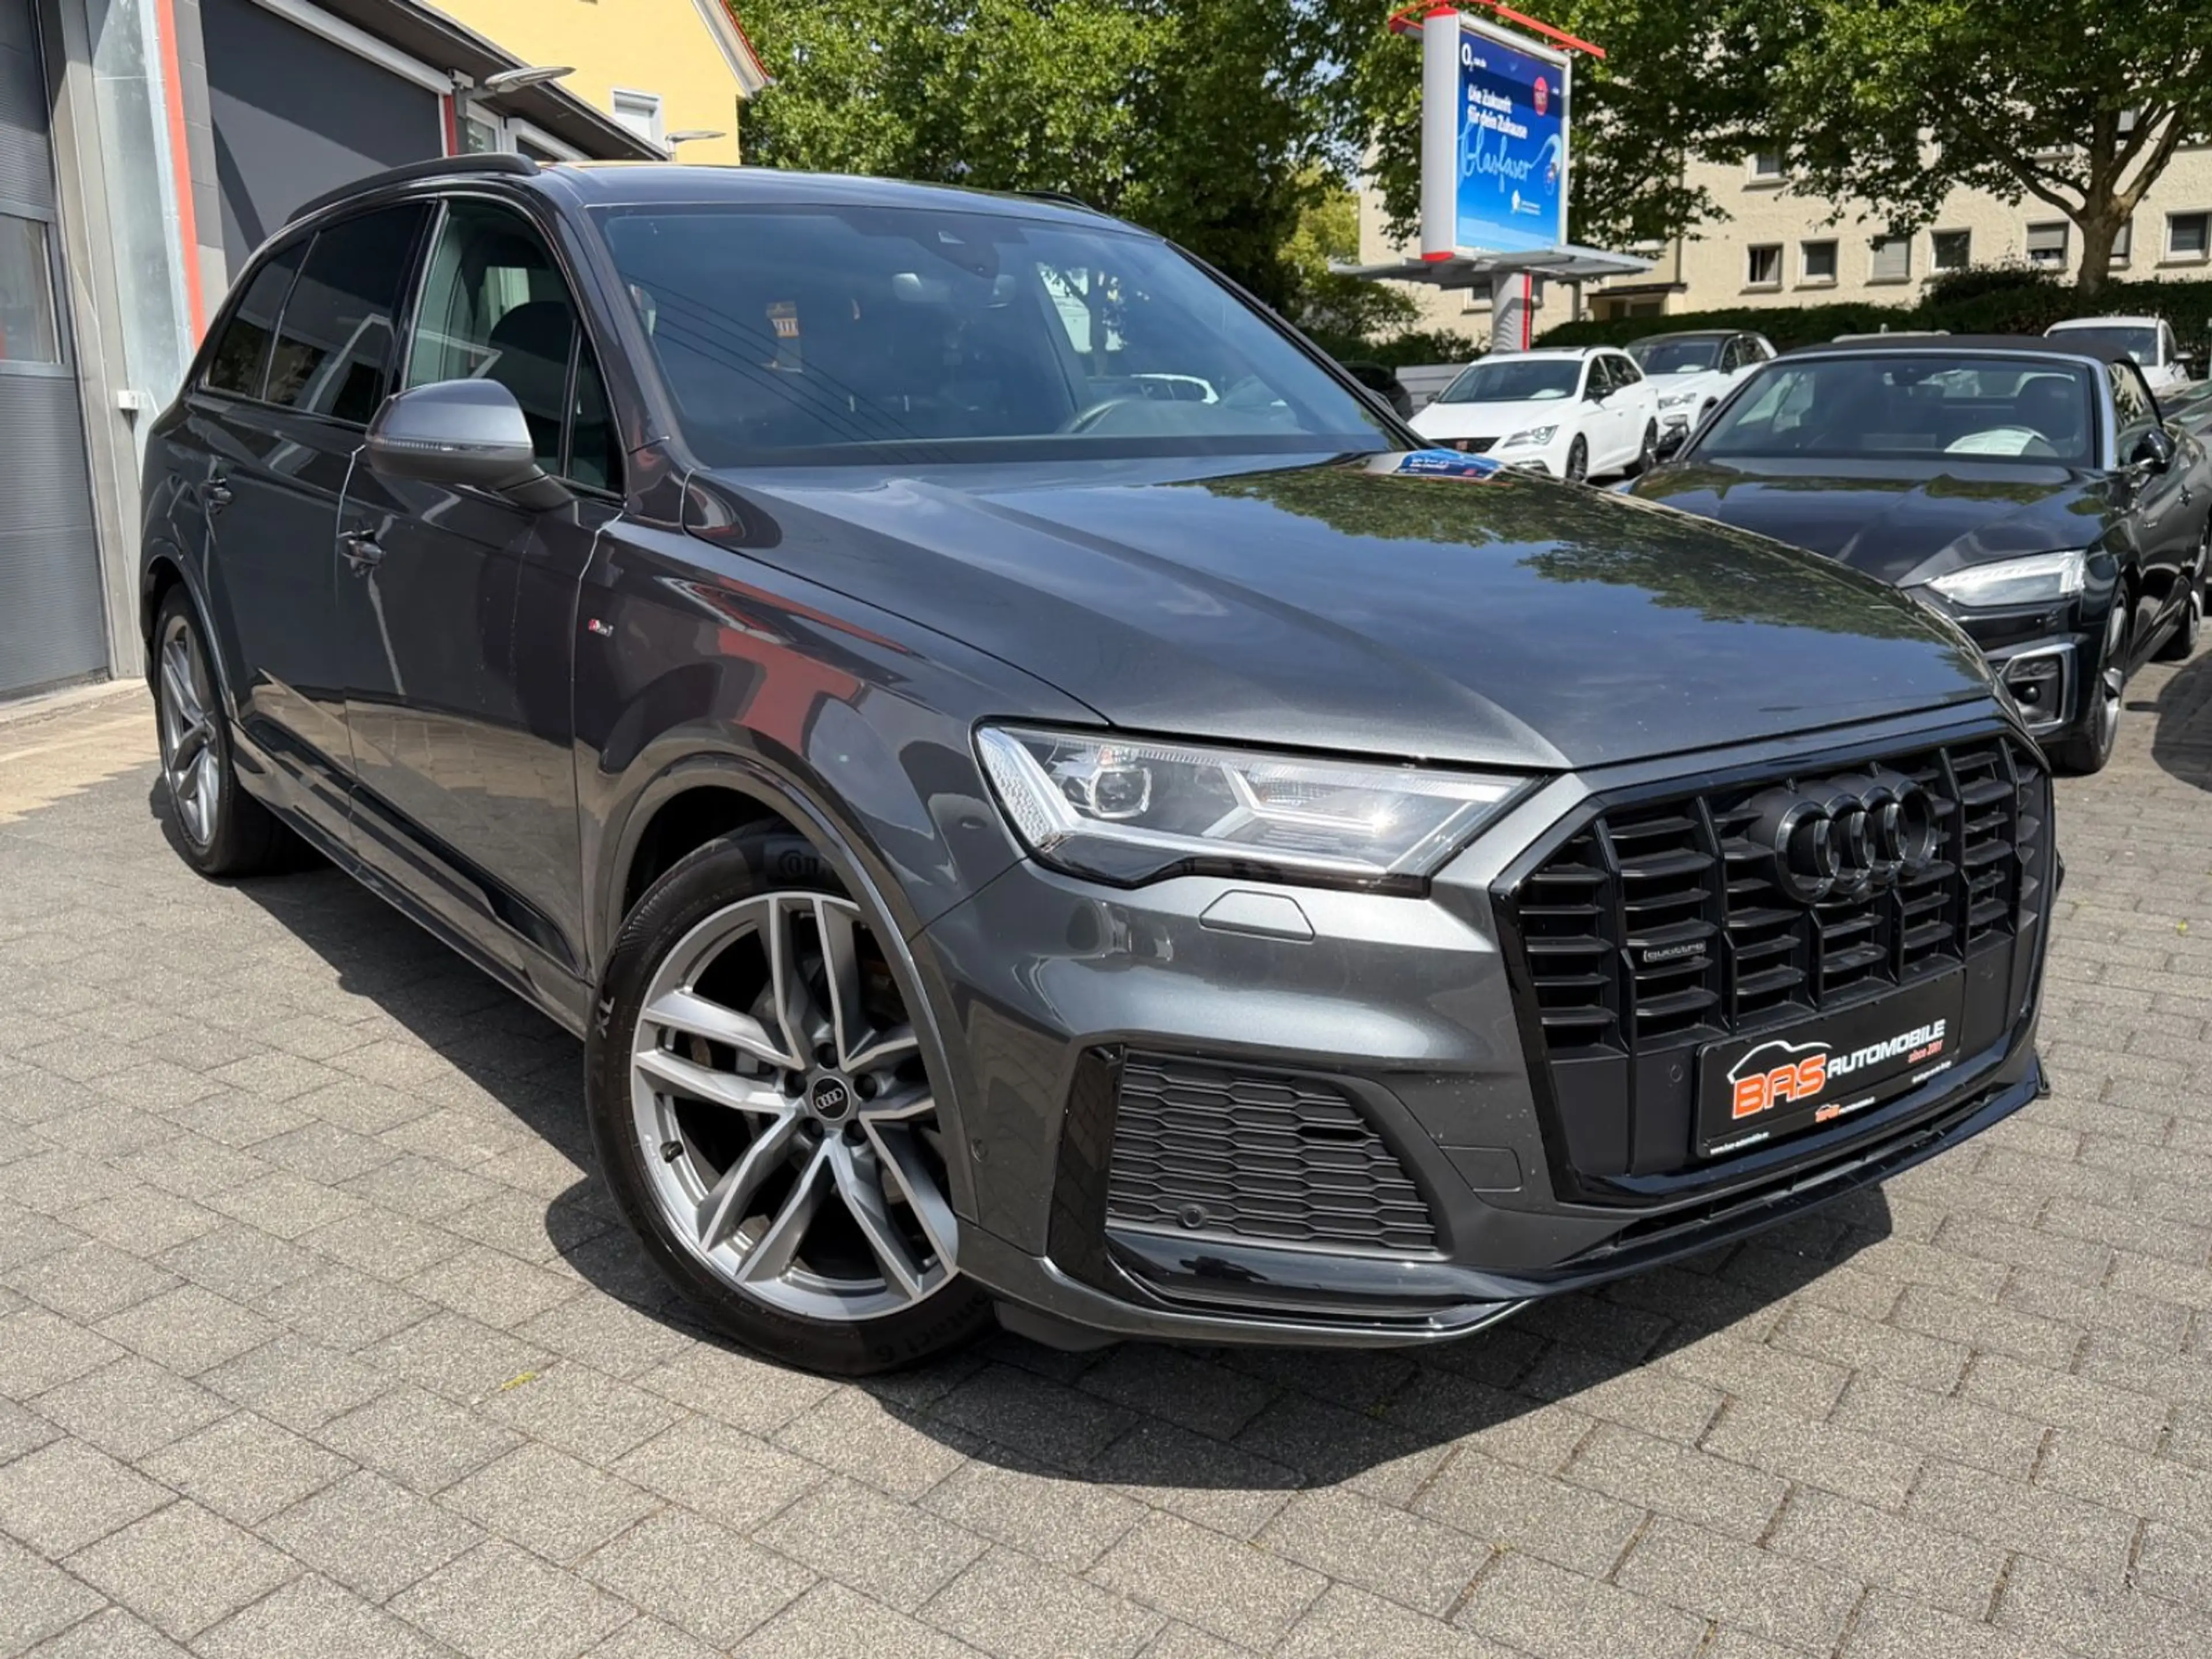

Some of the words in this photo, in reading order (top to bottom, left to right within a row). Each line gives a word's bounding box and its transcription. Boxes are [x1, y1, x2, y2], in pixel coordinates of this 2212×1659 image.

[1468, 83, 1482, 104] Die
[1732, 1054, 1827, 1120] BAS
[1827, 1018, 1946, 1079] AUTOMOBILE
